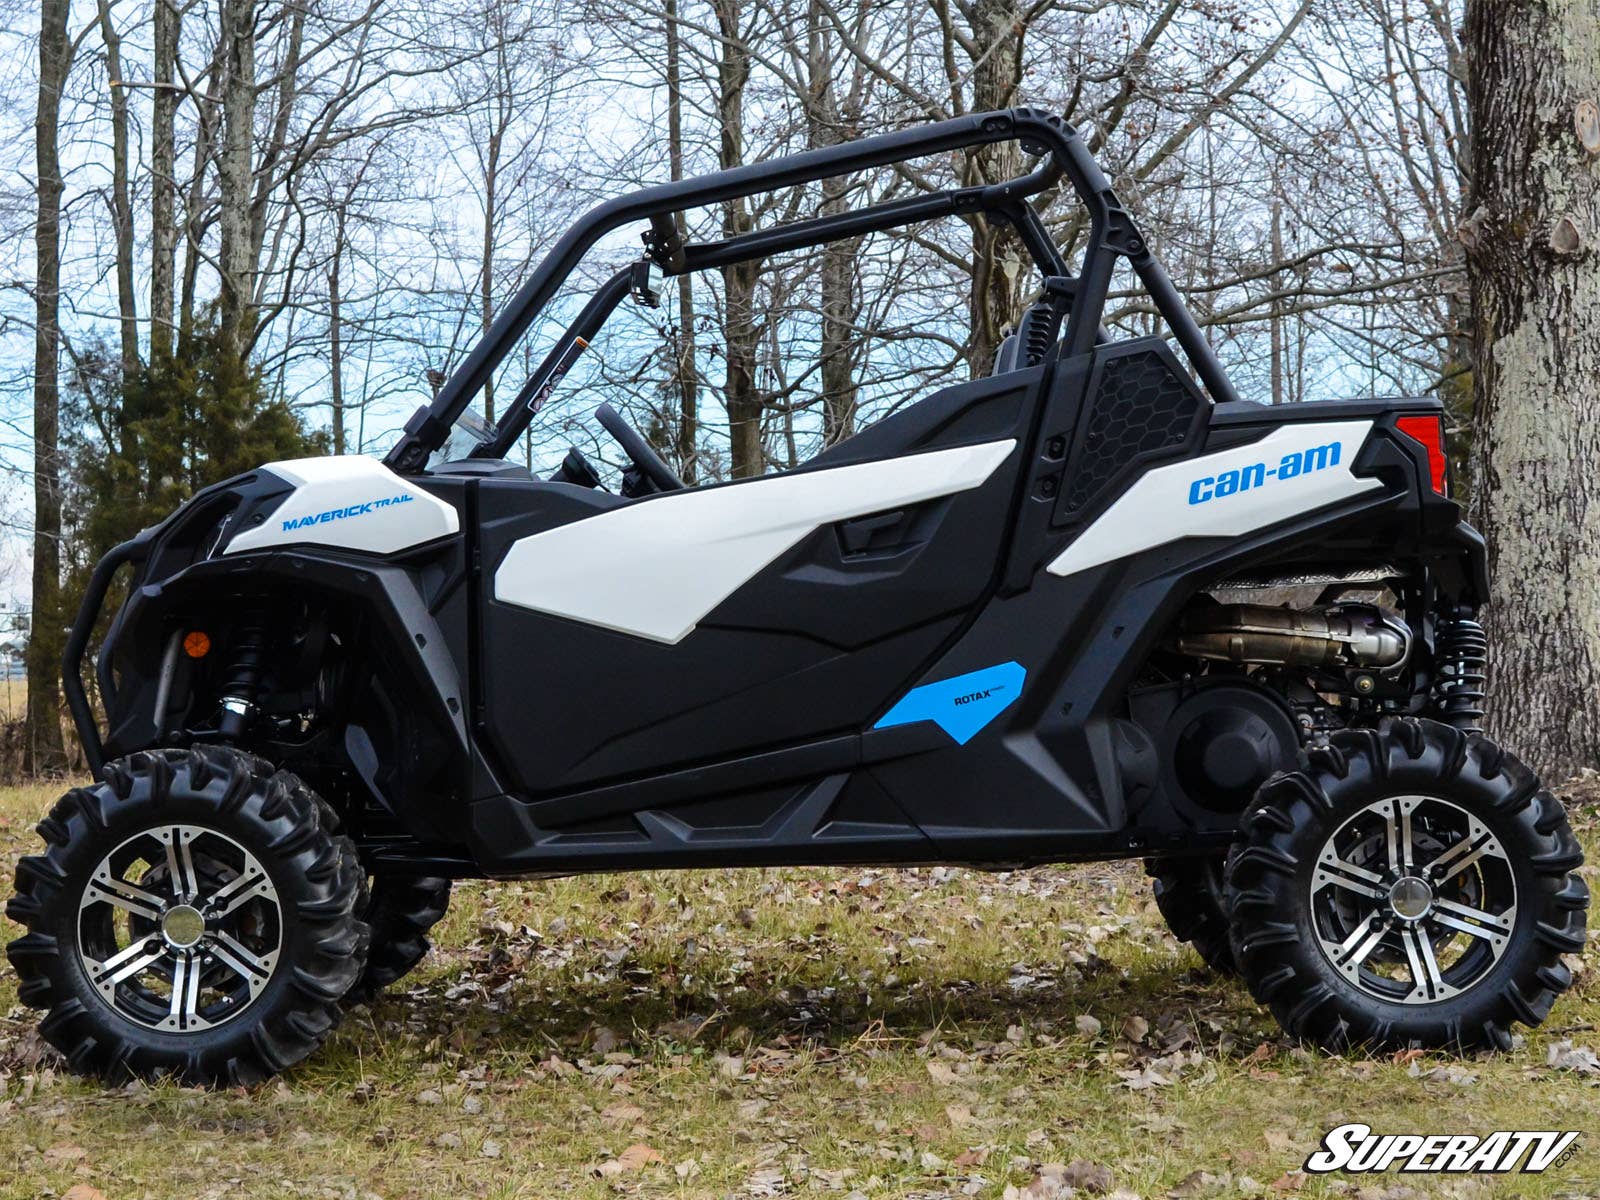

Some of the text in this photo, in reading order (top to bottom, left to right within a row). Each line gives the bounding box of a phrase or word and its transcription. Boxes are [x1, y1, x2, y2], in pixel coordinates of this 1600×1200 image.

[1188, 441, 1342, 506] can-am
[282, 494, 413, 532] MAVERICK TRAIL
[953, 689, 991, 707] ROTAX
